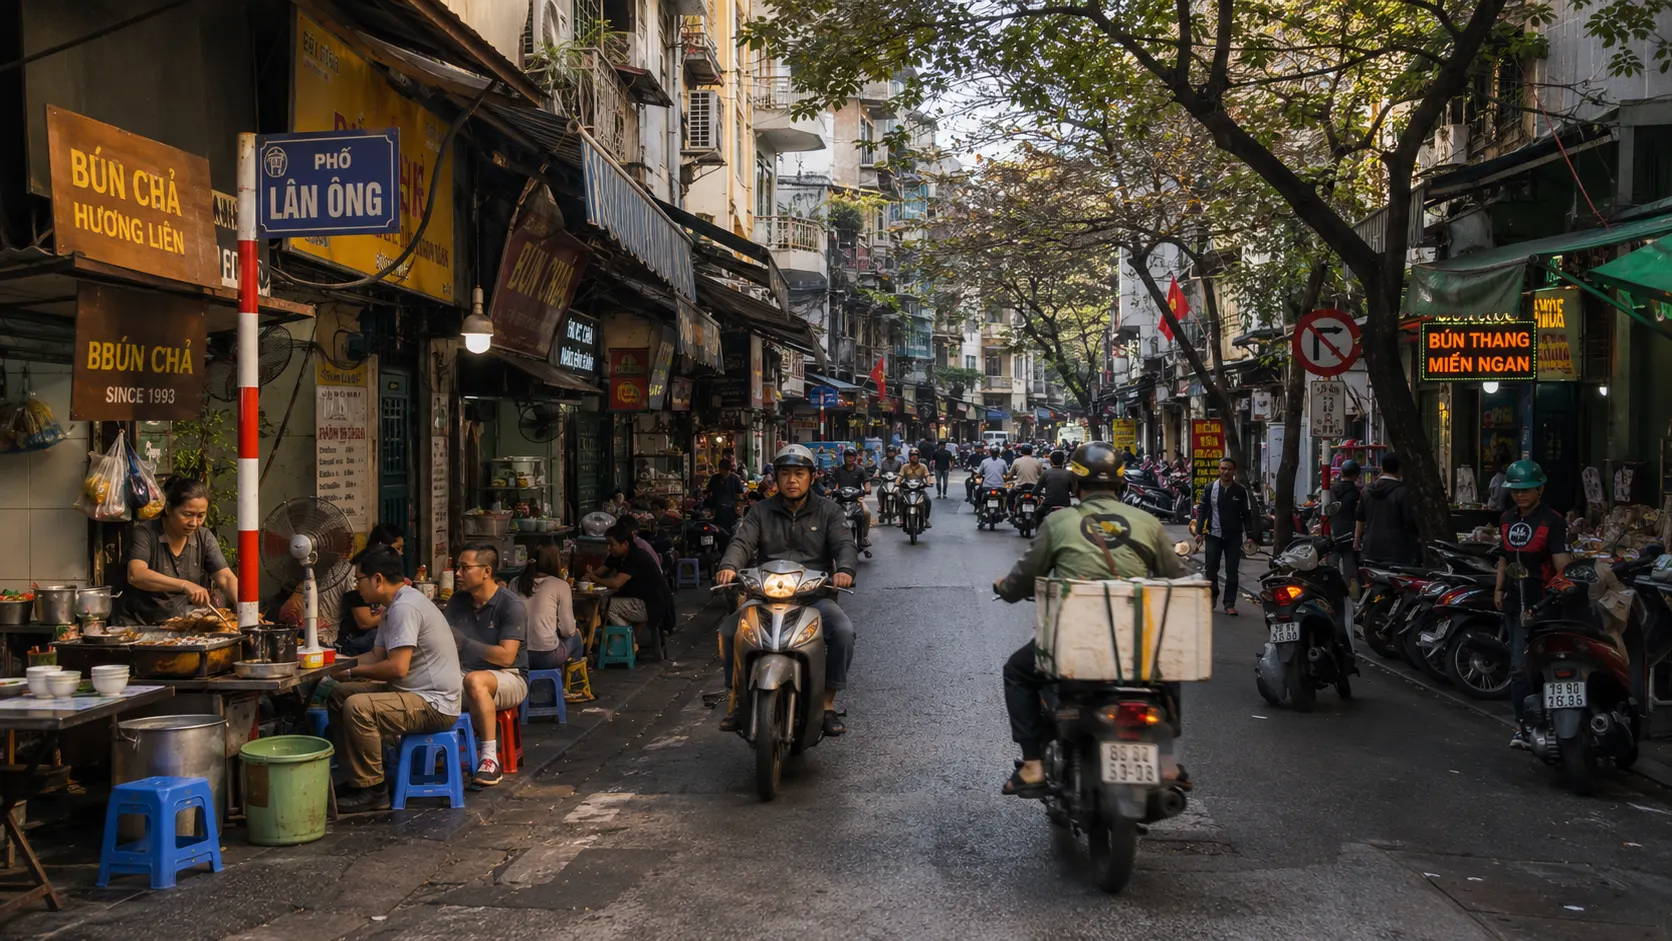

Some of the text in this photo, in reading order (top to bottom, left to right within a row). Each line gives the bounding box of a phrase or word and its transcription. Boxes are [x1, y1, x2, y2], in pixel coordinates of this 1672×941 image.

[314, 147, 351, 170] PHỐ
[71, 146, 126, 200] BÚN
[133, 168, 182, 217] CHẢ
[270, 178, 318, 220] LÂN
[327, 176, 382, 218] ÔNG
[74, 201, 185, 255] HƯƠNG LIÊN
[1428, 328, 1530, 349] BÚN THANG
[87, 336, 193, 375] BBÚN CHẢ
[1478, 356, 1530, 373] NGAN
[105, 386, 176, 404] SINCE 1993
